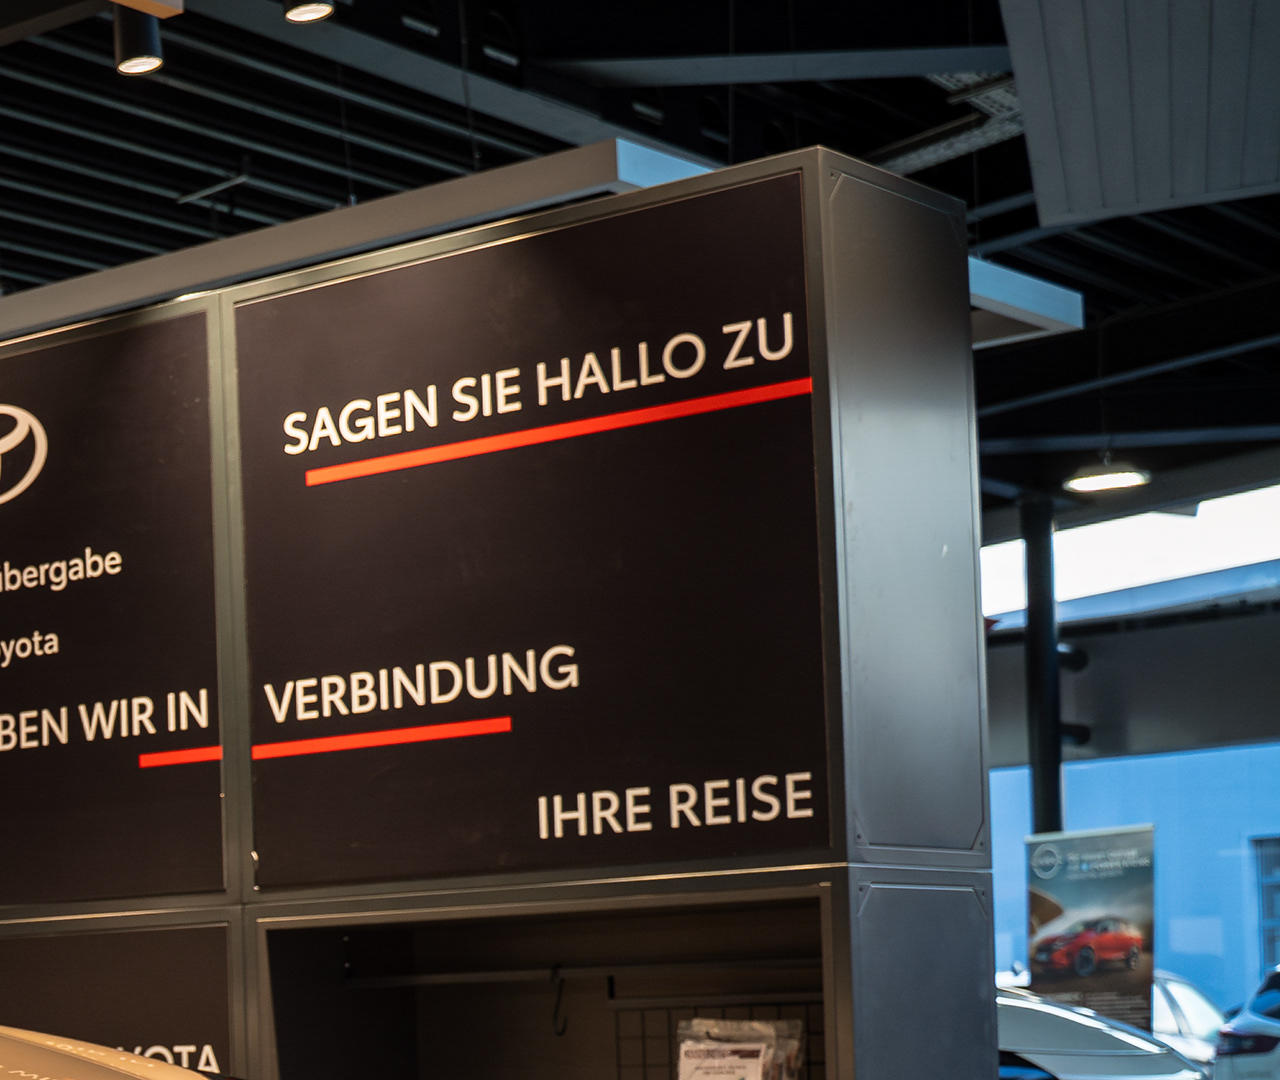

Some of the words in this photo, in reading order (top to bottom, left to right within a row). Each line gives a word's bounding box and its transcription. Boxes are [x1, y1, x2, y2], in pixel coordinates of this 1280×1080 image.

[283, 384, 438, 455] SAGEN
[452, 367, 523, 423] SIE
[536, 331, 706, 406] HALLO
[721, 311, 794, 371] ZU
[77, 696, 158, 741] WIR
[166, 688, 209, 732] IN
[264, 645, 580, 723] VERBINDUNG
[538, 787, 654, 840] IHRE
[669, 771, 814, 829] REISE
